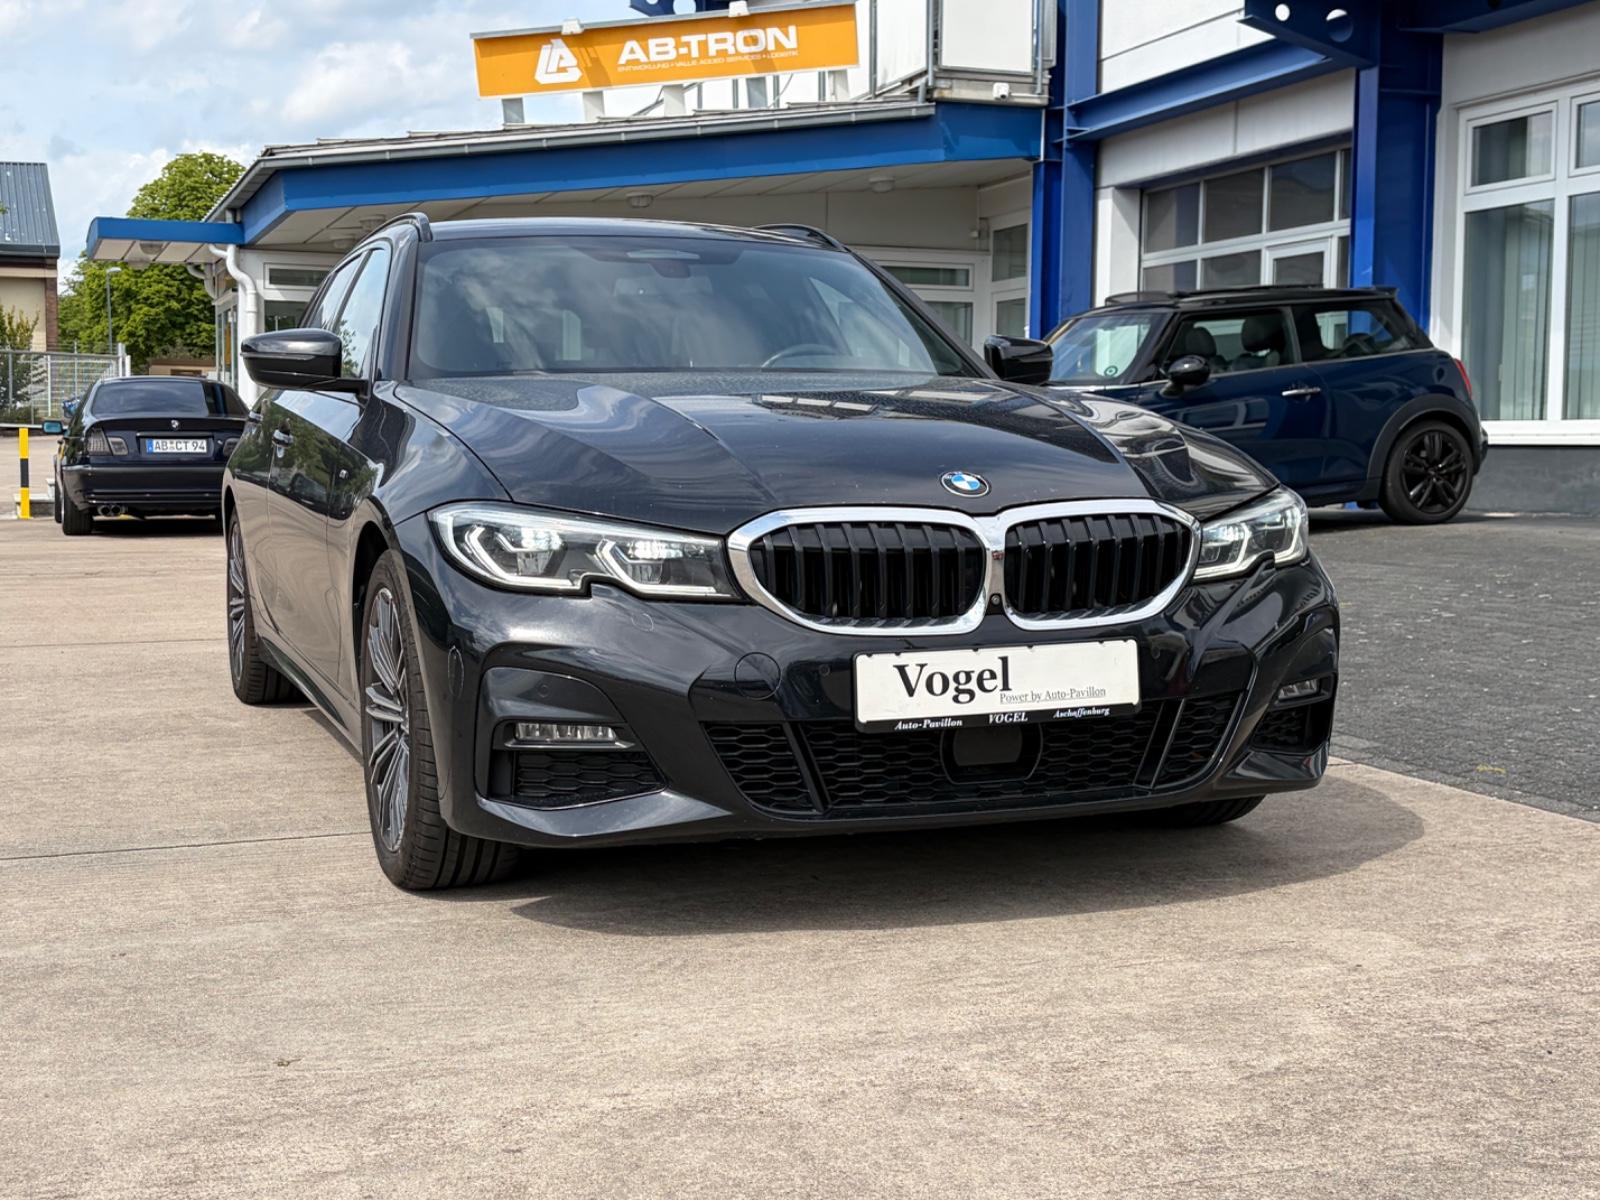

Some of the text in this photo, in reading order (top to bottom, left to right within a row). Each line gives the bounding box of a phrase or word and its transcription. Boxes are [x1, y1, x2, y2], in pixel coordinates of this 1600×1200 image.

[617, 25, 798, 65] AB-TRON
[155, 440, 205, 450] AB CT 94
[893, 656, 1013, 704] Vogel
[999, 686, 1107, 704] Power by Auto-Pavillon
[894, 706, 1110, 731] Auto-Pavillon VOGEL Aschaffenburg
